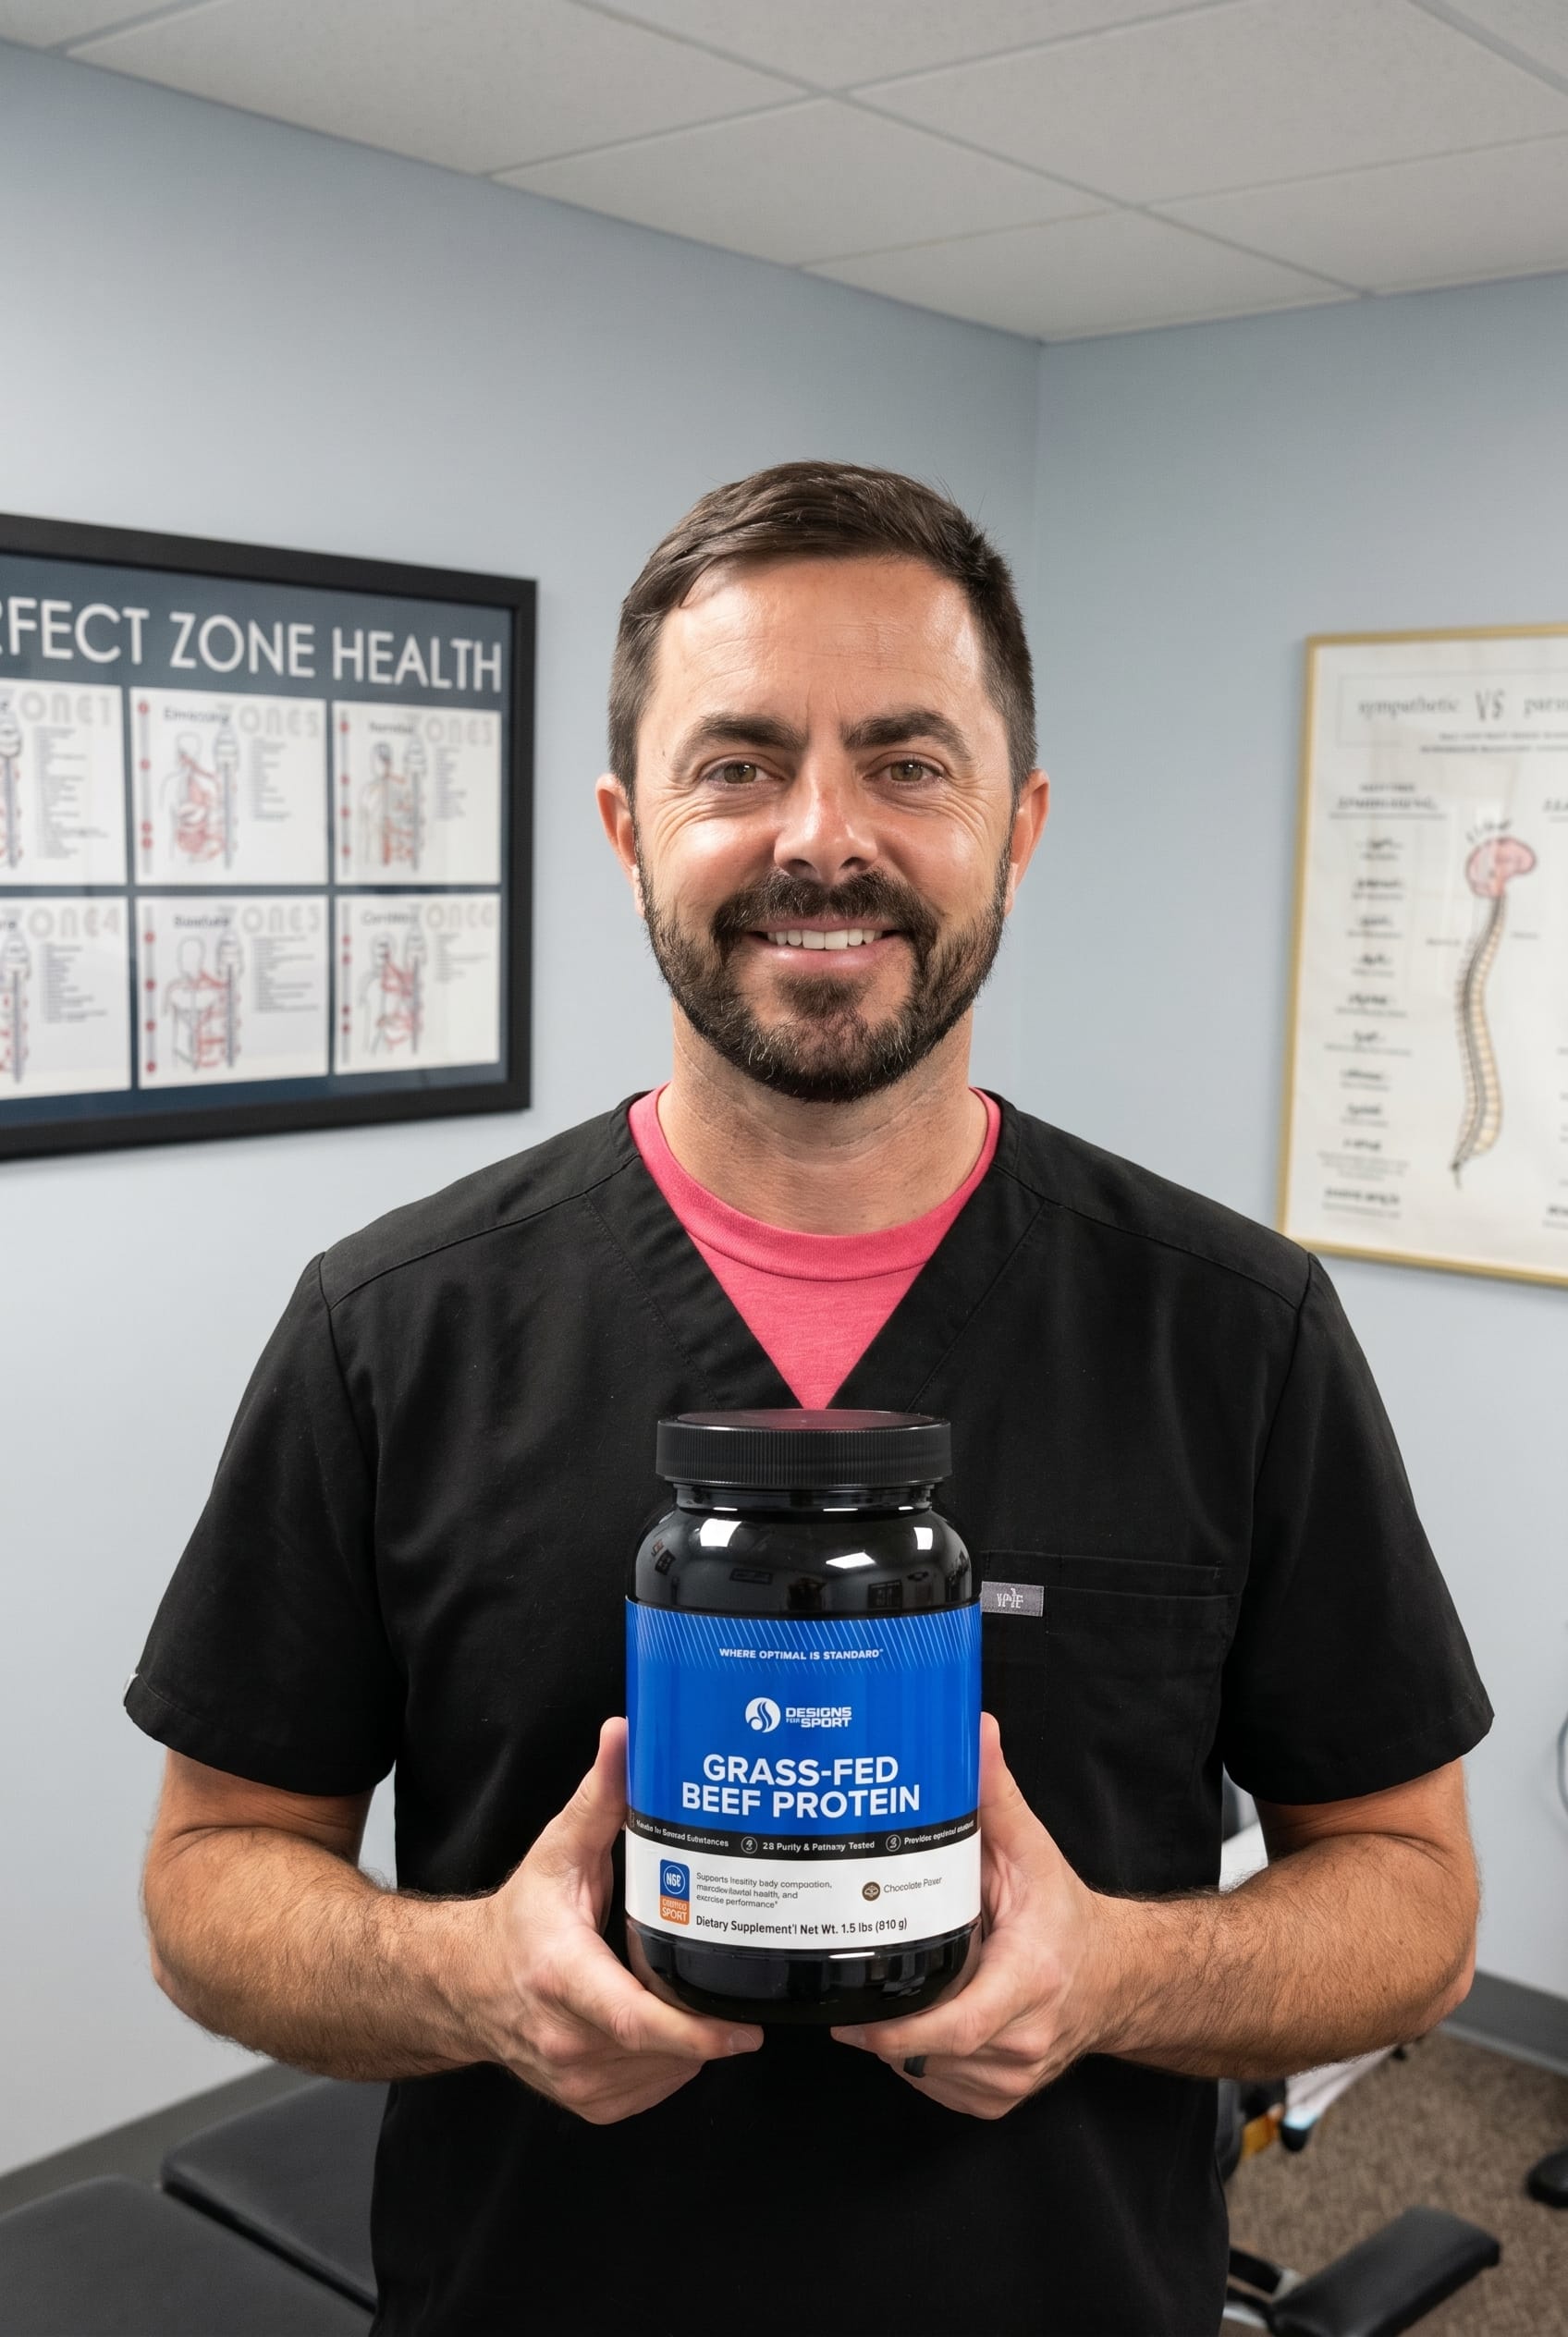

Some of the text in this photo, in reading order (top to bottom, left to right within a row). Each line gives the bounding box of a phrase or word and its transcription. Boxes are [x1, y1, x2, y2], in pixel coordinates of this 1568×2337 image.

[0, 595, 502, 692] FECT ZONE HEALTH
[1476, 689, 1504, 722] VS
[719, 1648, 756, 1658] WHERE
[759, 1650, 806, 1660] OPTIMAL
[810, 1652, 820, 1660] IS
[786, 1707, 851, 1718] DESIGNS
[801, 1718, 852, 1728] SPORT
[703, 1754, 899, 1786] GRASS-FED
[682, 1781, 920, 1818] BEEF PROTEIN
[849, 1841, 876, 1850] Tested
[883, 1882, 923, 1893] Chocolate
[662, 1906, 688, 1922] SPORT
[696, 1915, 729, 1932] Dietary
[800, 1924, 818, 1934] Net
[821, 1924, 839, 1934] Wt.
[841, 1923, 856, 1934] 1.5
[858, 1922, 873, 1932] lbs
[875, 1919, 897, 1933] (810
[898, 1917, 908, 1930] g)
